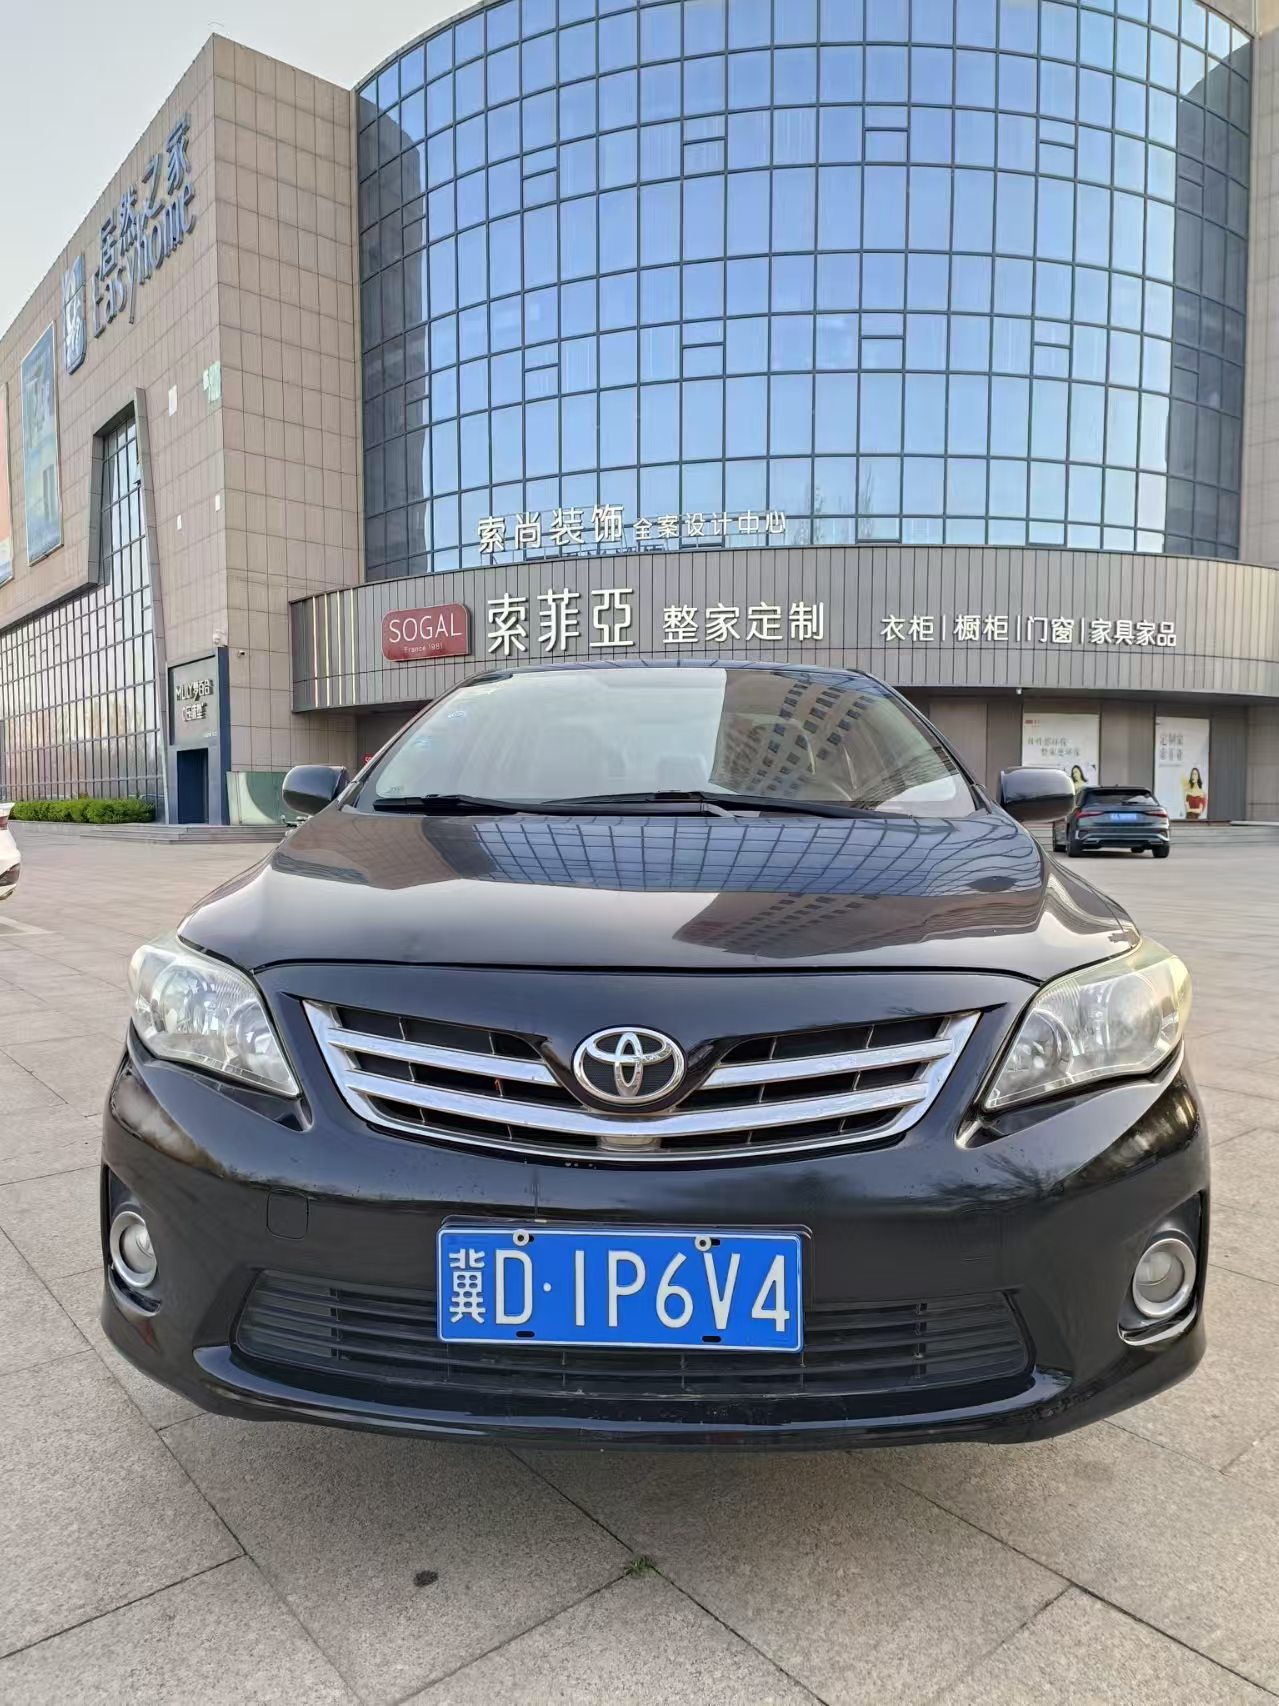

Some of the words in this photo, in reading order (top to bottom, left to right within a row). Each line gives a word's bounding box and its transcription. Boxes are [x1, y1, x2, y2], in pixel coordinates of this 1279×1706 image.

[100, 112, 192, 282] 居然之家
[477, 503, 625, 554] 索尚装饰
[633, 509, 786, 541] 全案设计中心
[388, 612, 463, 643] SOGAL
[661, 601, 825, 644] 整家定制
